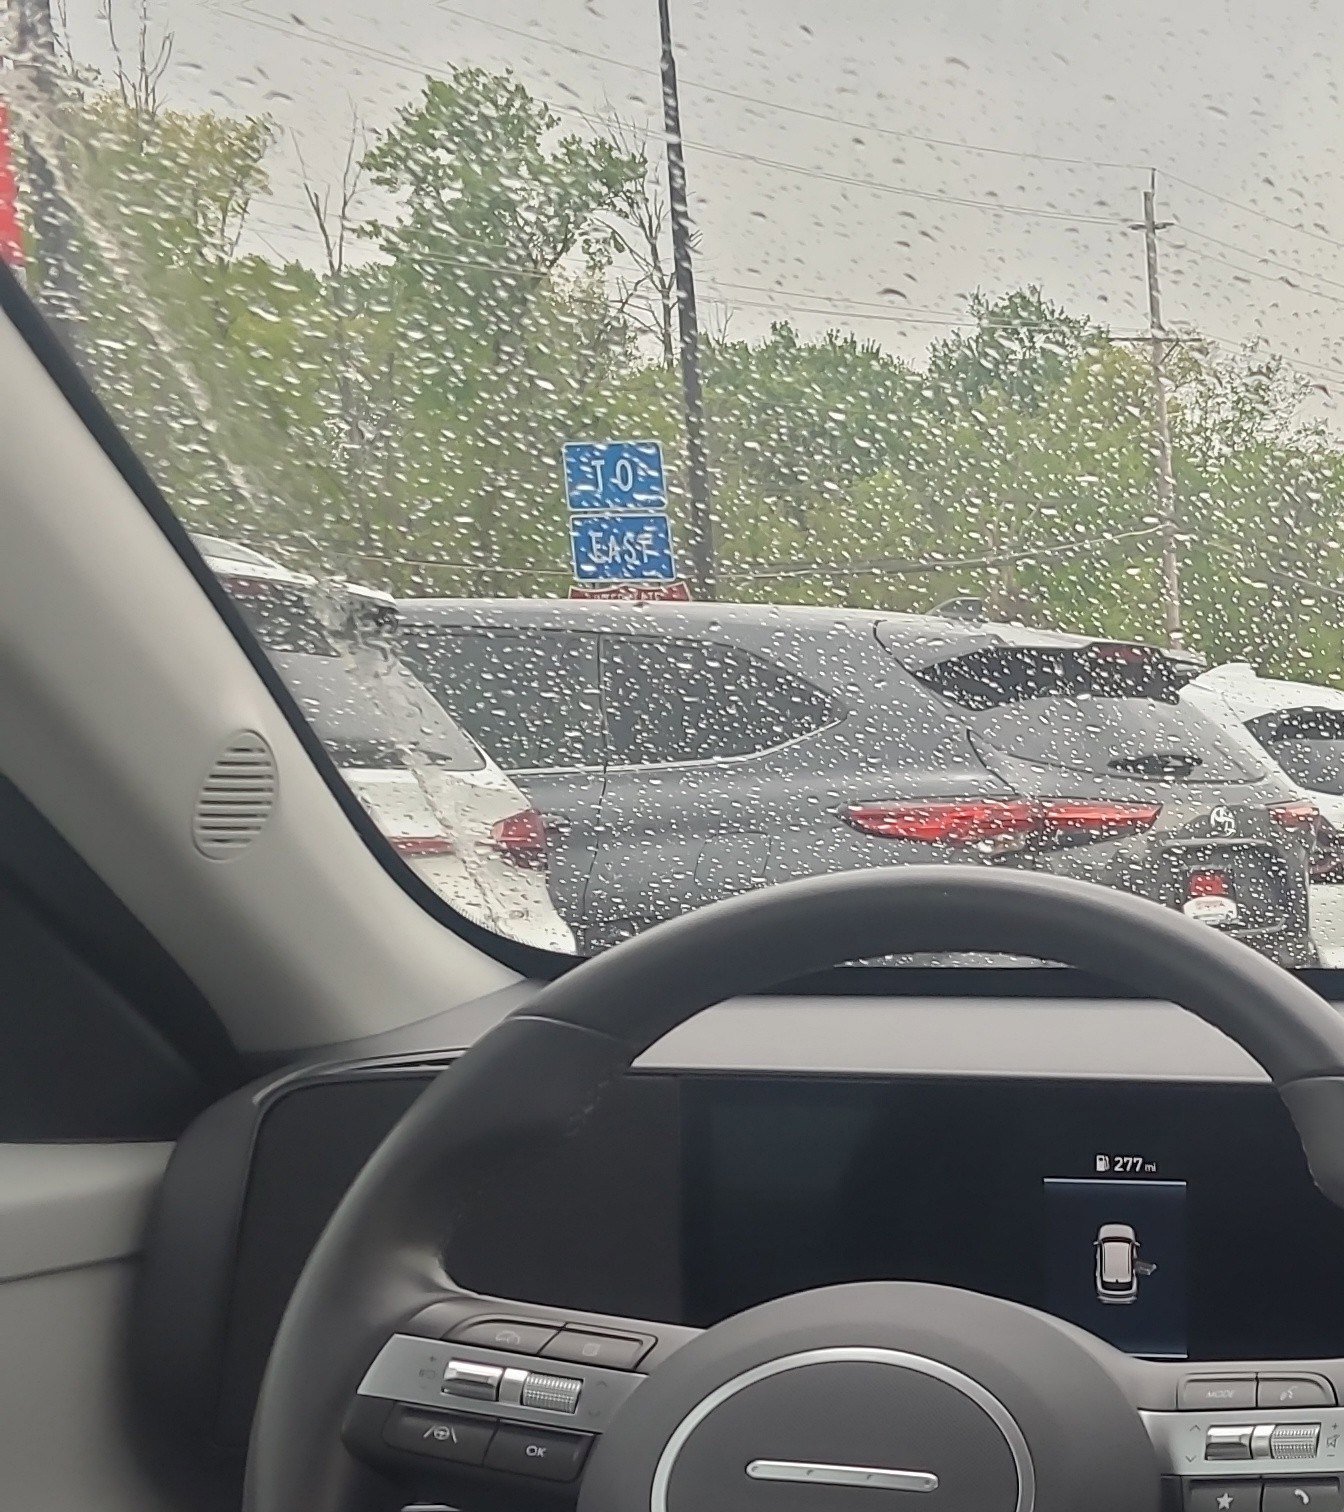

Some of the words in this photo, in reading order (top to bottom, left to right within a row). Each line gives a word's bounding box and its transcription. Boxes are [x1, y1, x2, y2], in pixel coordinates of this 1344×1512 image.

[591, 459, 633, 493] TO
[588, 531, 653, 565] EAST
[1114, 1157, 1143, 1172] 277
[1145, 1162, 1157, 1172] mi
[525, 1445, 547, 1458] OK
